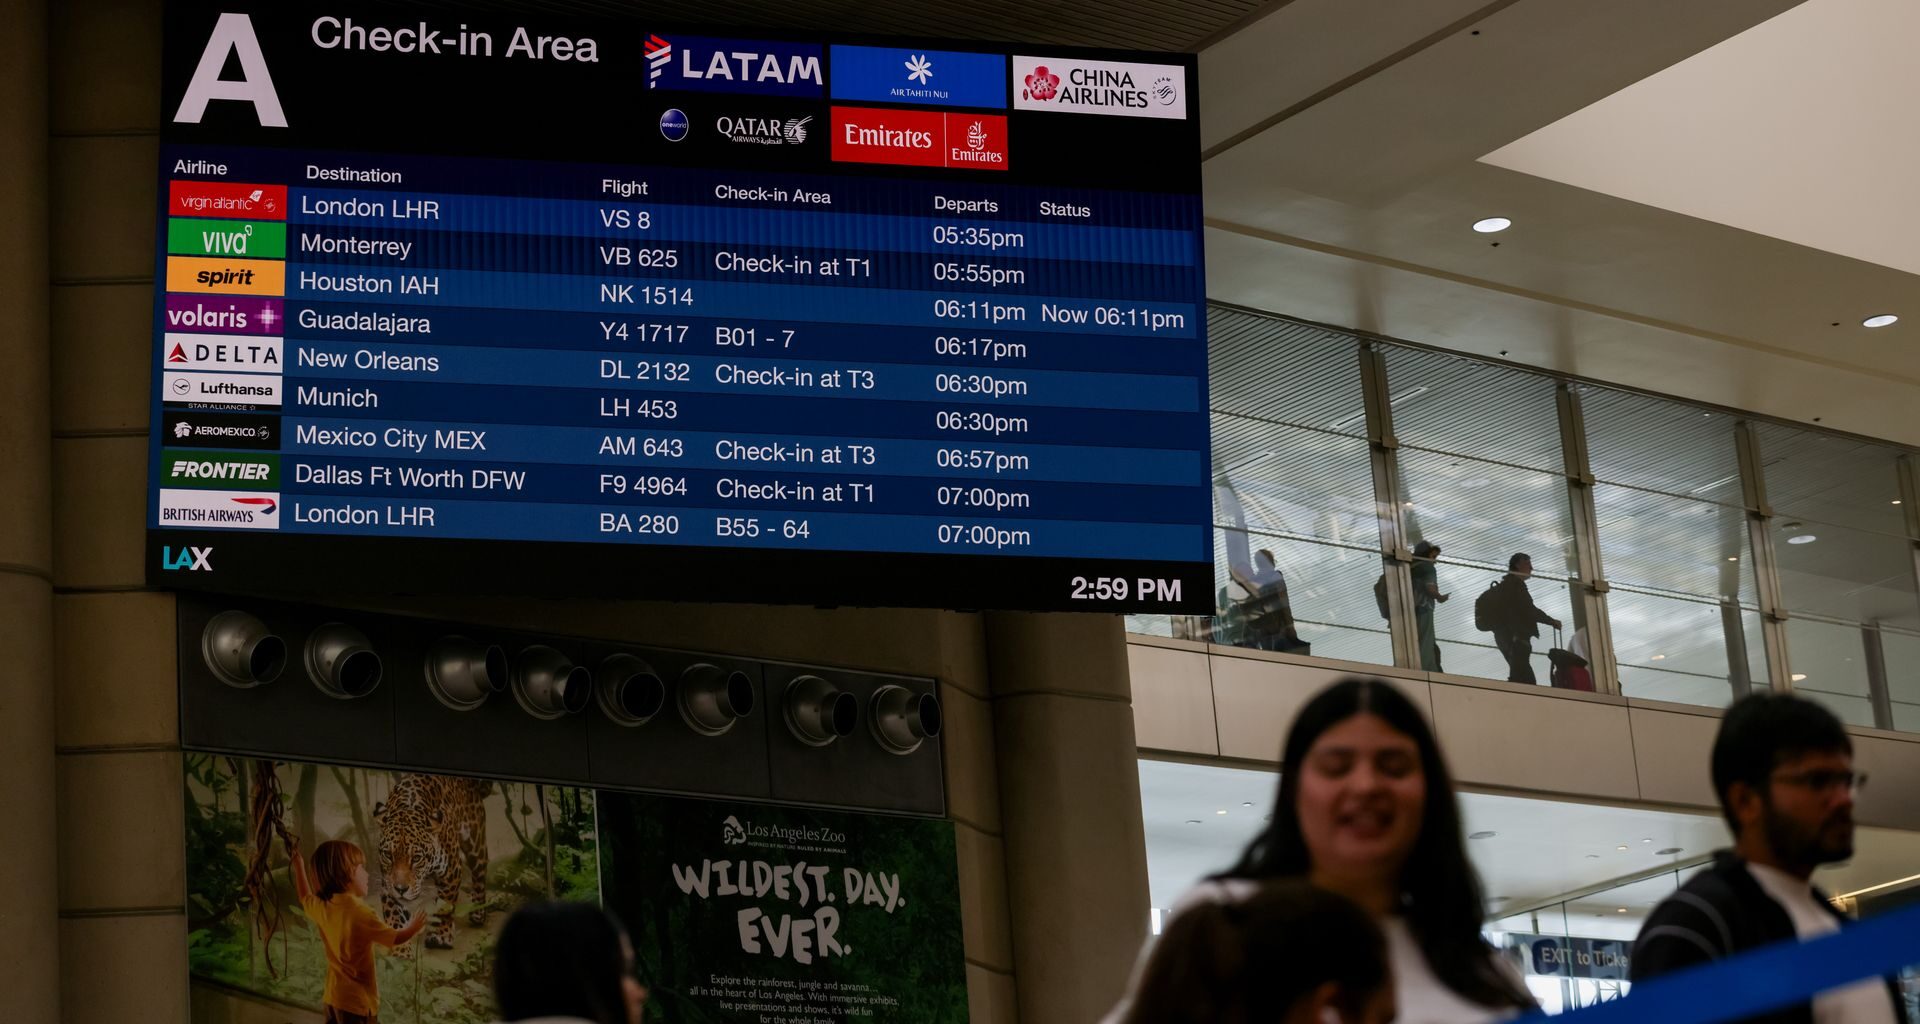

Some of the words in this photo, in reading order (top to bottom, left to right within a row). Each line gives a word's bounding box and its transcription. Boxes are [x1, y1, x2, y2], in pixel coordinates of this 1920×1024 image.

[312, 16, 491, 56] Check-in
[506, 27, 598, 62] Area
[173, 13, 288, 127] A
[683, 50, 822, 85] LATAM
[1070, 68, 1135, 88] CHINA
[891, 88, 905, 96] AIR
[906, 89, 932, 98] TAHITI
[1059, 88, 1148, 108] AIRLINES
[717, 117, 781, 138] QATAR
[845, 123, 932, 149] Emirates
[952, 148, 1002, 163] Emirates
[174, 160, 227, 175] Airline
[307, 165, 401, 183] Destination
[603, 179, 648, 197] Flight
[715, 185, 787, 201] Check-in
[793, 189, 831, 203] Area
[303, 196, 384, 216] London
[393, 200, 438, 219] LHR
[935, 196, 998, 213] Departs
[1040, 202, 1090, 217] Status
[601, 209, 630, 228] VS
[638, 212, 650, 229] 8
[302, 233, 411, 260] Monterrey
[934, 226, 1023, 250] 05:35pm
[600, 247, 631, 265] VB
[639, 249, 677, 267] 625
[716, 252, 811, 274] Check-in
[820, 259, 839, 275] at
[846, 259, 869, 276] T1
[196, 267, 255, 287] spirit
[301, 271, 391, 293] Houston
[401, 276, 438, 295] IAH
[934, 263, 1024, 286] 05:55pm
[602, 284, 633, 303] NK
[642, 287, 693, 305] 1514
[168, 305, 247, 329] volaris
[935, 300, 1025, 323] 06:11pm
[1042, 304, 1088, 323] Now
[1095, 307, 1183, 331] 06:11pm
[299, 309, 430, 336] Guadalajara
[600, 322, 628, 340] Y4
[638, 324, 688, 342] 1717
[717, 327, 754, 346] B01
[783, 330, 794, 347] 7
[195, 344, 279, 364] DELTA
[936, 337, 1026, 360] 06:17pm
[299, 348, 347, 367] New
[355, 350, 439, 371] Orleans
[601, 360, 630, 378] DL
[637, 362, 689, 381] 2132
[716, 364, 812, 386] Check-in
[821, 370, 840, 387] at
[847, 370, 874, 389] T3
[201, 382, 273, 395] Lufthansa
[298, 386, 377, 407] Munich
[936, 374, 1026, 398] 06:30pm
[601, 398, 629, 416] LH
[638, 400, 677, 418] 453
[195, 426, 255, 436] AEROMEXICO
[937, 412, 1027, 435] 06:30pm
[297, 425, 376, 446] Mexico
[384, 428, 427, 452] City
[436, 430, 485, 450] MEX
[599, 436, 635, 455] AM
[644, 438, 683, 457] 643
[716, 440, 813, 462] Check-in
[822, 446, 841, 463] at
[848, 446, 875, 464] T3
[937, 449, 1028, 473] 06:57pm
[172, 461, 270, 480] FRONTIER
[296, 464, 362, 484] Dallas
[371, 467, 391, 485] Ft
[399, 468, 463, 488] Worth
[473, 470, 525, 490] DFW
[601, 475, 626, 493] F9
[634, 477, 687, 495] 4964
[717, 479, 814, 500] Check-in
[823, 484, 842, 501] at
[849, 484, 872, 502] T1
[938, 487, 1029, 511] 07:00pm
[163, 507, 205, 521] BRITISH
[207, 508, 254, 523] AIRWAYS
[296, 503, 378, 524] London
[388, 506, 434, 526] LHR
[601, 513, 632, 532] BA
[639, 515, 678, 534] 280
[717, 517, 759, 537] B55
[784, 520, 809, 538] 64
[938, 525, 1030, 549] 07:00pm
[163, 546, 213, 571] LAX
[1072, 577, 1128, 600] 2:59
[1138, 578, 1181, 601] PM
[747, 821, 768, 836] Los
[770, 824, 819, 843] Angeles
[821, 828, 845, 843] Zoo
[672, 859, 836, 908] WILDEST.
[844, 867, 906, 914] DAY.
[737, 906, 852, 965] EVER.
[1541, 947, 1572, 963] EXIT
[1577, 950, 1590, 965] to
[1593, 951, 1631, 967] Ticke
[711, 974, 741, 986] Explore
[743, 976, 755, 985] the
[799, 980, 822, 991] jungle
[824, 981, 838, 990] and
[690, 986, 698, 995] all
[700, 987, 708, 995] in
[710, 988, 723, 996] the
[725, 988, 747, 998] heart
[749, 989, 757, 998] of
[759, 990, 772, 999] Los
[807, 992, 828, 1001] With
[830, 994, 867, 1004] immersive
[720, 1001, 733, 1009] live
[735, 1002, 785, 1012] presentations
[787, 1005, 802, 1013] and
[844, 1007, 859, 1015] wild
[860, 1008, 873, 1016] fun
[760, 1015, 771, 1023] for
[773, 1016, 786, 1024] the
[788, 1016, 812, 1024] whole
